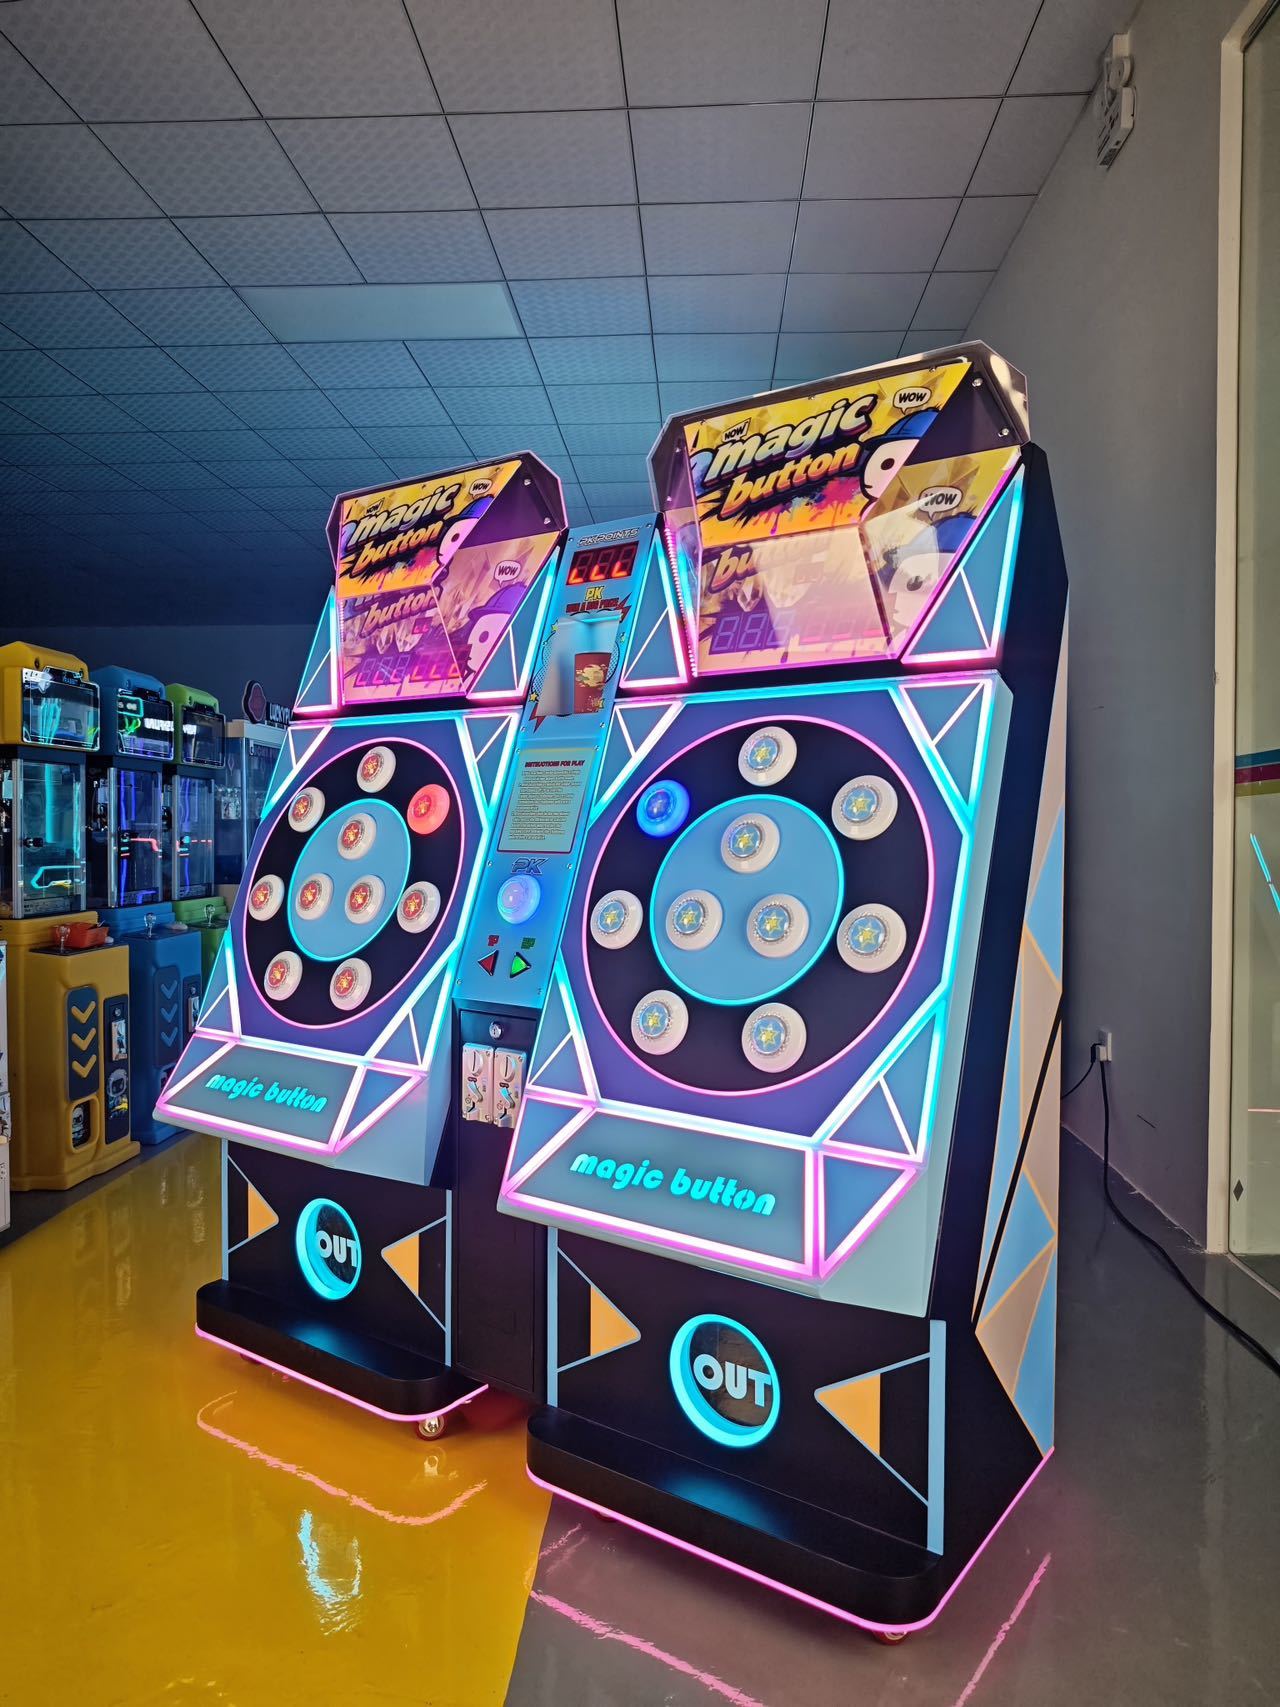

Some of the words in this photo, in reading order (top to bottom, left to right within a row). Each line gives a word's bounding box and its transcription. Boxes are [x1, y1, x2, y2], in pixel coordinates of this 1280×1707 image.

[898, 392, 927, 404] WOW
[704, 394, 878, 484] magic
[472, 481, 490, 492] WOW
[718, 443, 861, 519] button
[923, 492, 958, 507] WOW
[346, 484, 461, 547] magic
[351, 520, 444, 577] button
[498, 564, 518, 577] WOW
[511, 857, 548, 874] PK
[205, 1074, 264, 1100] magic
[264, 1082, 327, 1113] button
[570, 1153, 664, 1190] magic
[670, 1168, 776, 1216] button
[315, 1230, 358, 1267] OUT
[693, 1353, 772, 1408] OUT
